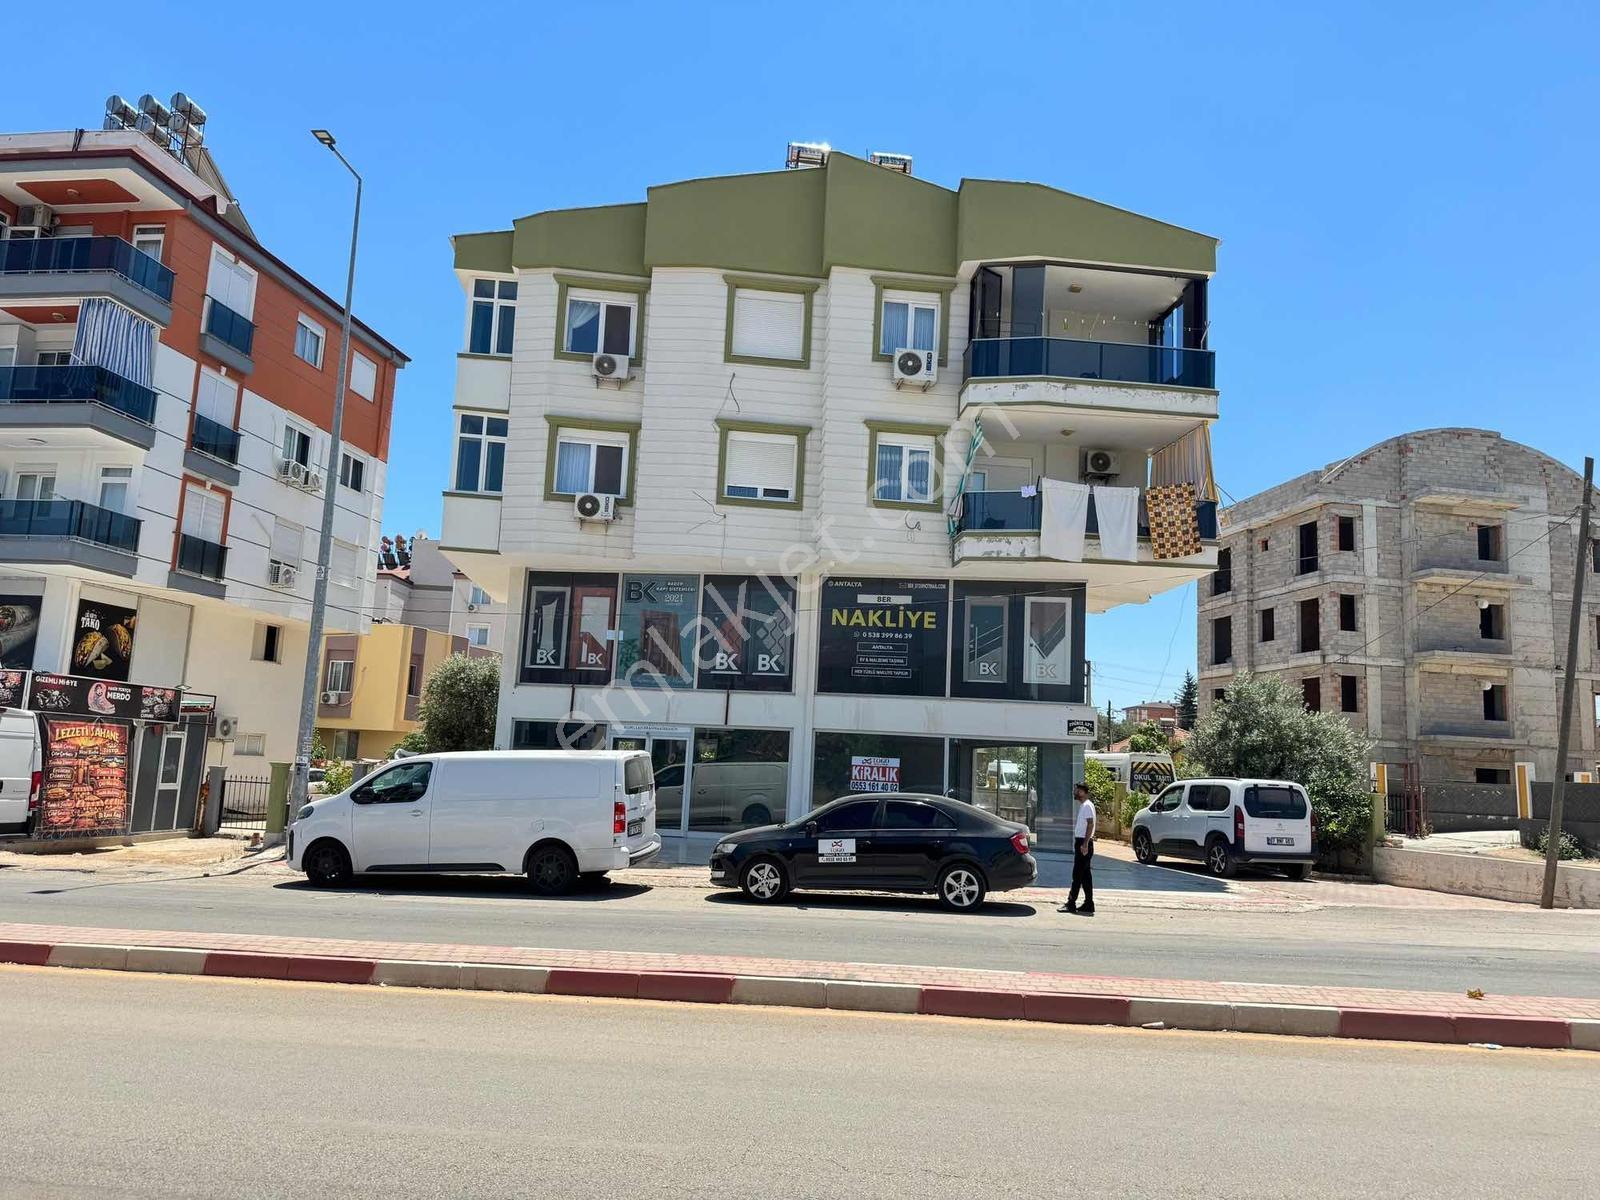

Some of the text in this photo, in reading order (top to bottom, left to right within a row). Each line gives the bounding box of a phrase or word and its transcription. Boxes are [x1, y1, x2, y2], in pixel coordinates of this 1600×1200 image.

[625, 581, 658, 603] BK
[81, 616, 100, 630] TAKO
[831, 605, 937, 629] NAKLİYE
[536, 649, 556, 665] BK
[587, 652, 603, 665] BK
[715, 652, 739, 670] BK
[757, 654, 780, 672] BK
[979, 662, 998, 676] BK
[1036, 664, 1057, 678] BK
[106, 691, 131, 701] MERDO
[851, 781, 867, 790] 0553
[868, 782, 879, 791] 161
[881, 783, 889, 791] 40
